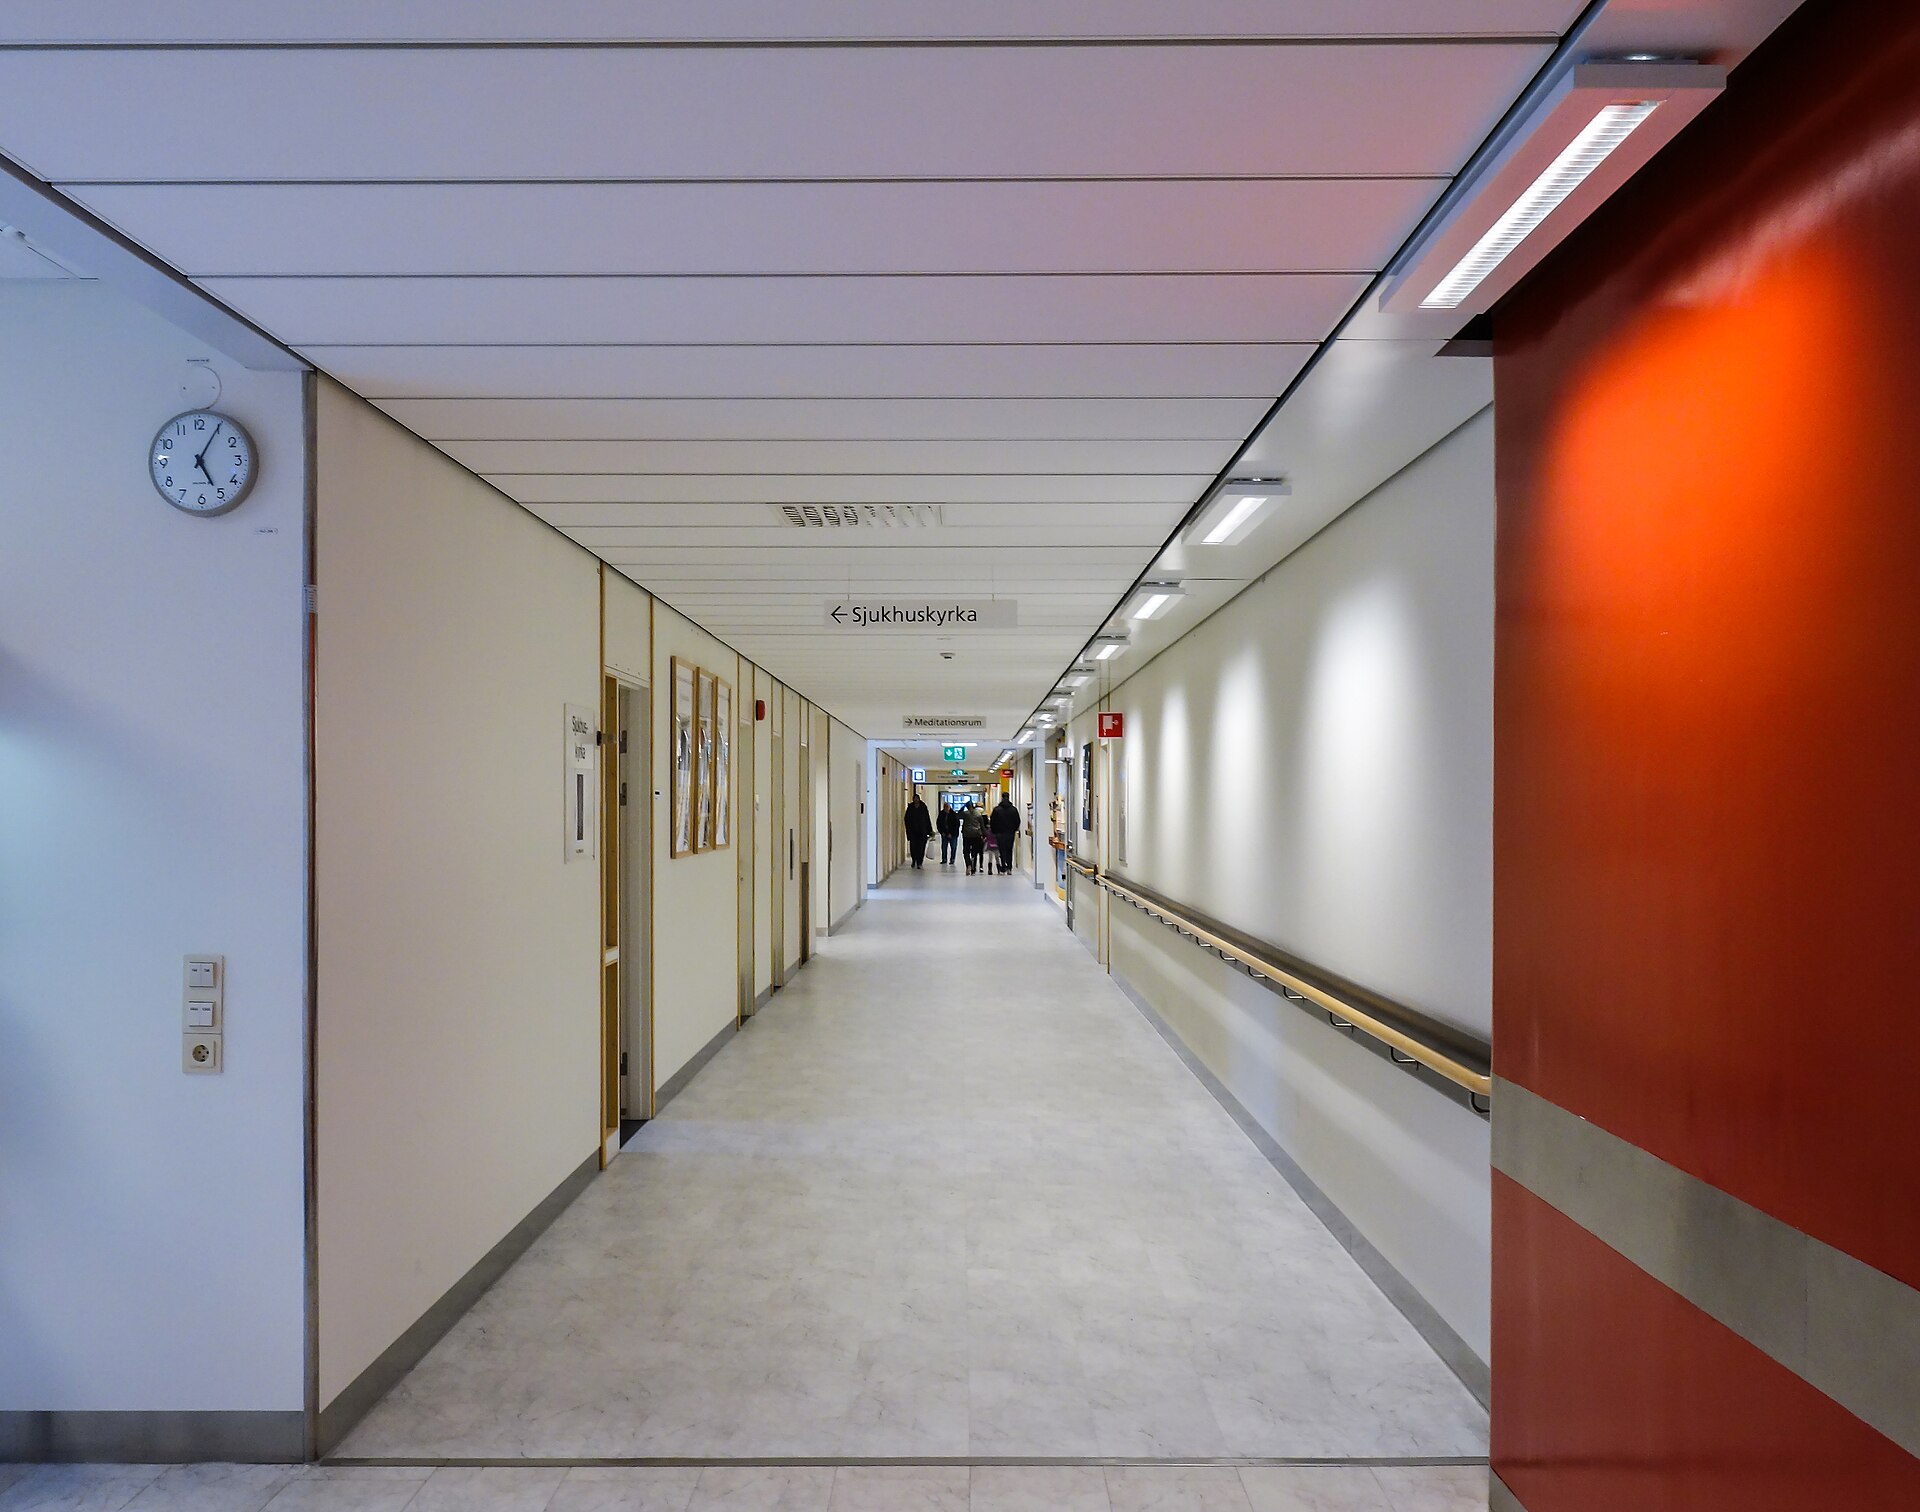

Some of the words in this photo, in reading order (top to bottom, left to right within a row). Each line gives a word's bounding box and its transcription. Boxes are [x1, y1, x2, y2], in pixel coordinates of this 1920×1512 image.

[176, 424, 186, 436] 11
[194, 419, 205, 431] 12
[162, 439, 173, 450] 10
[228, 436, 237, 448] 2
[159, 457, 168, 468] 9
[234, 455, 242, 466] 3
[165, 476, 173, 487] 8
[229, 474, 238, 485] 4
[179, 489, 187, 500] 7
[197, 493, 206, 505] 6
[216, 488, 225, 499] 5
[851, 605, 978, 626] Sjukhuskyrka
[914, 717, 982, 727] Meditationsrum
